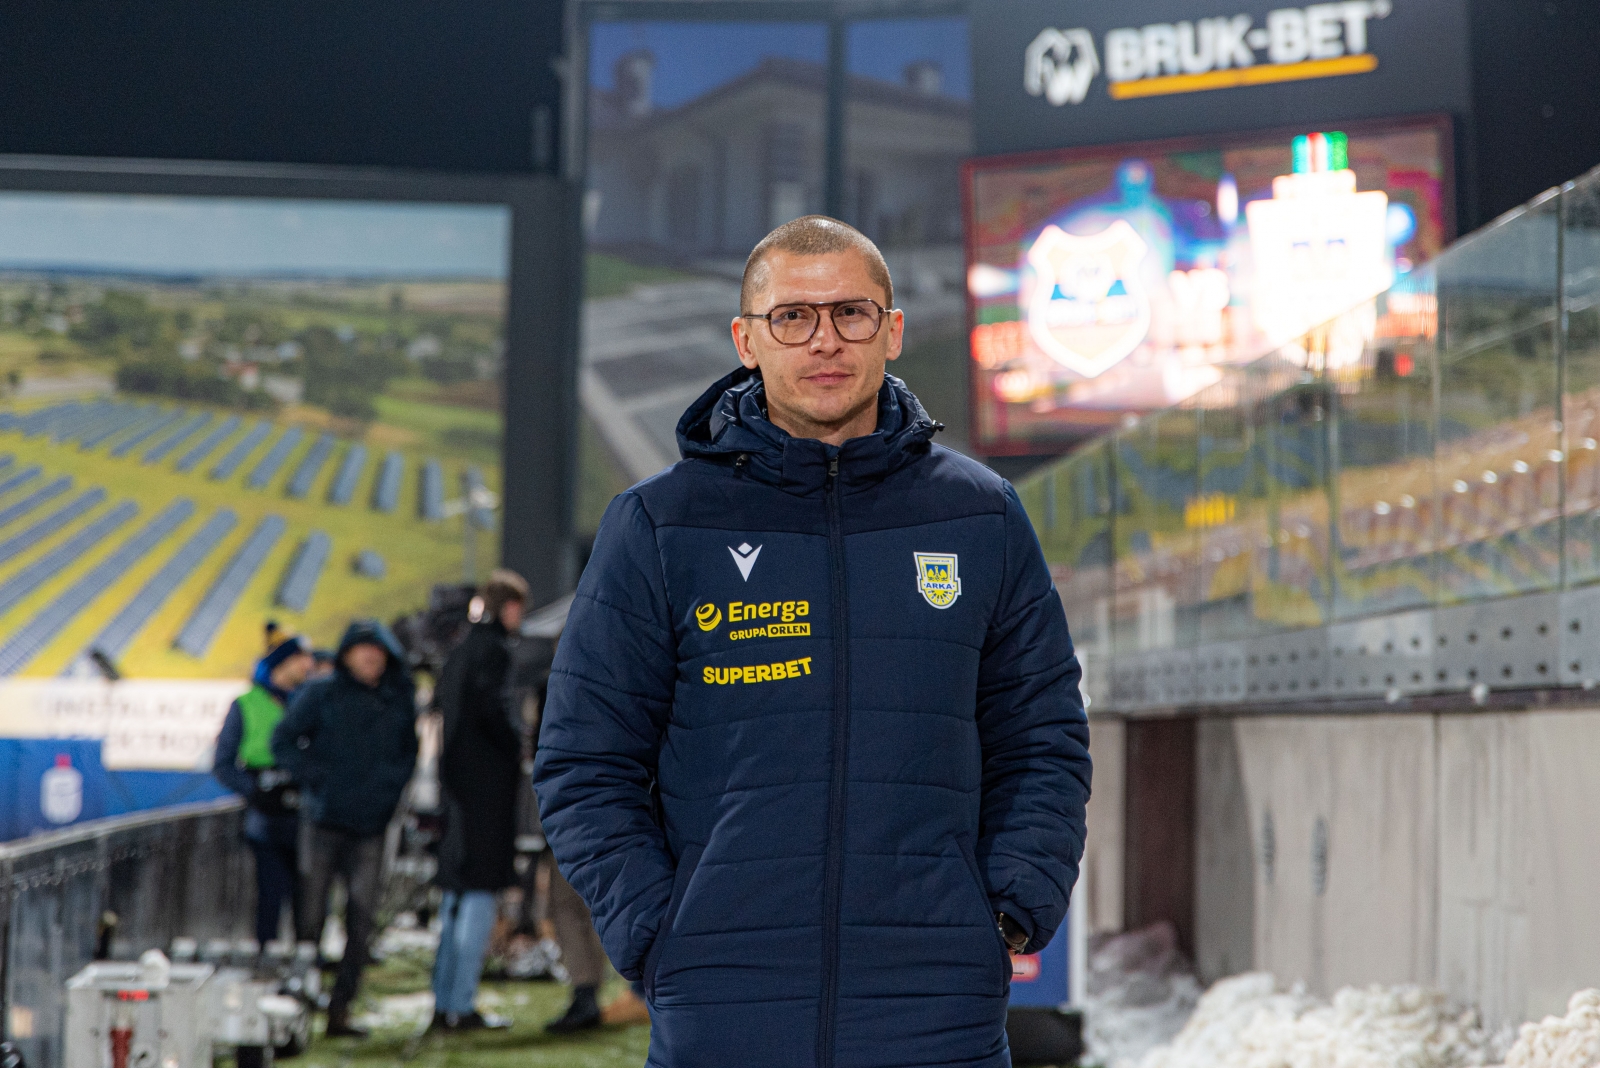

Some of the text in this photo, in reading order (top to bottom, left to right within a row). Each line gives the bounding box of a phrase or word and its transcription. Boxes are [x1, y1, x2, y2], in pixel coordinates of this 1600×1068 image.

[926, 582, 953, 590] ARKA
[728, 600, 810, 623] Energa
[729, 625, 808, 641] GRUPA ORLEN
[702, 657, 812, 685] SUPERBET
